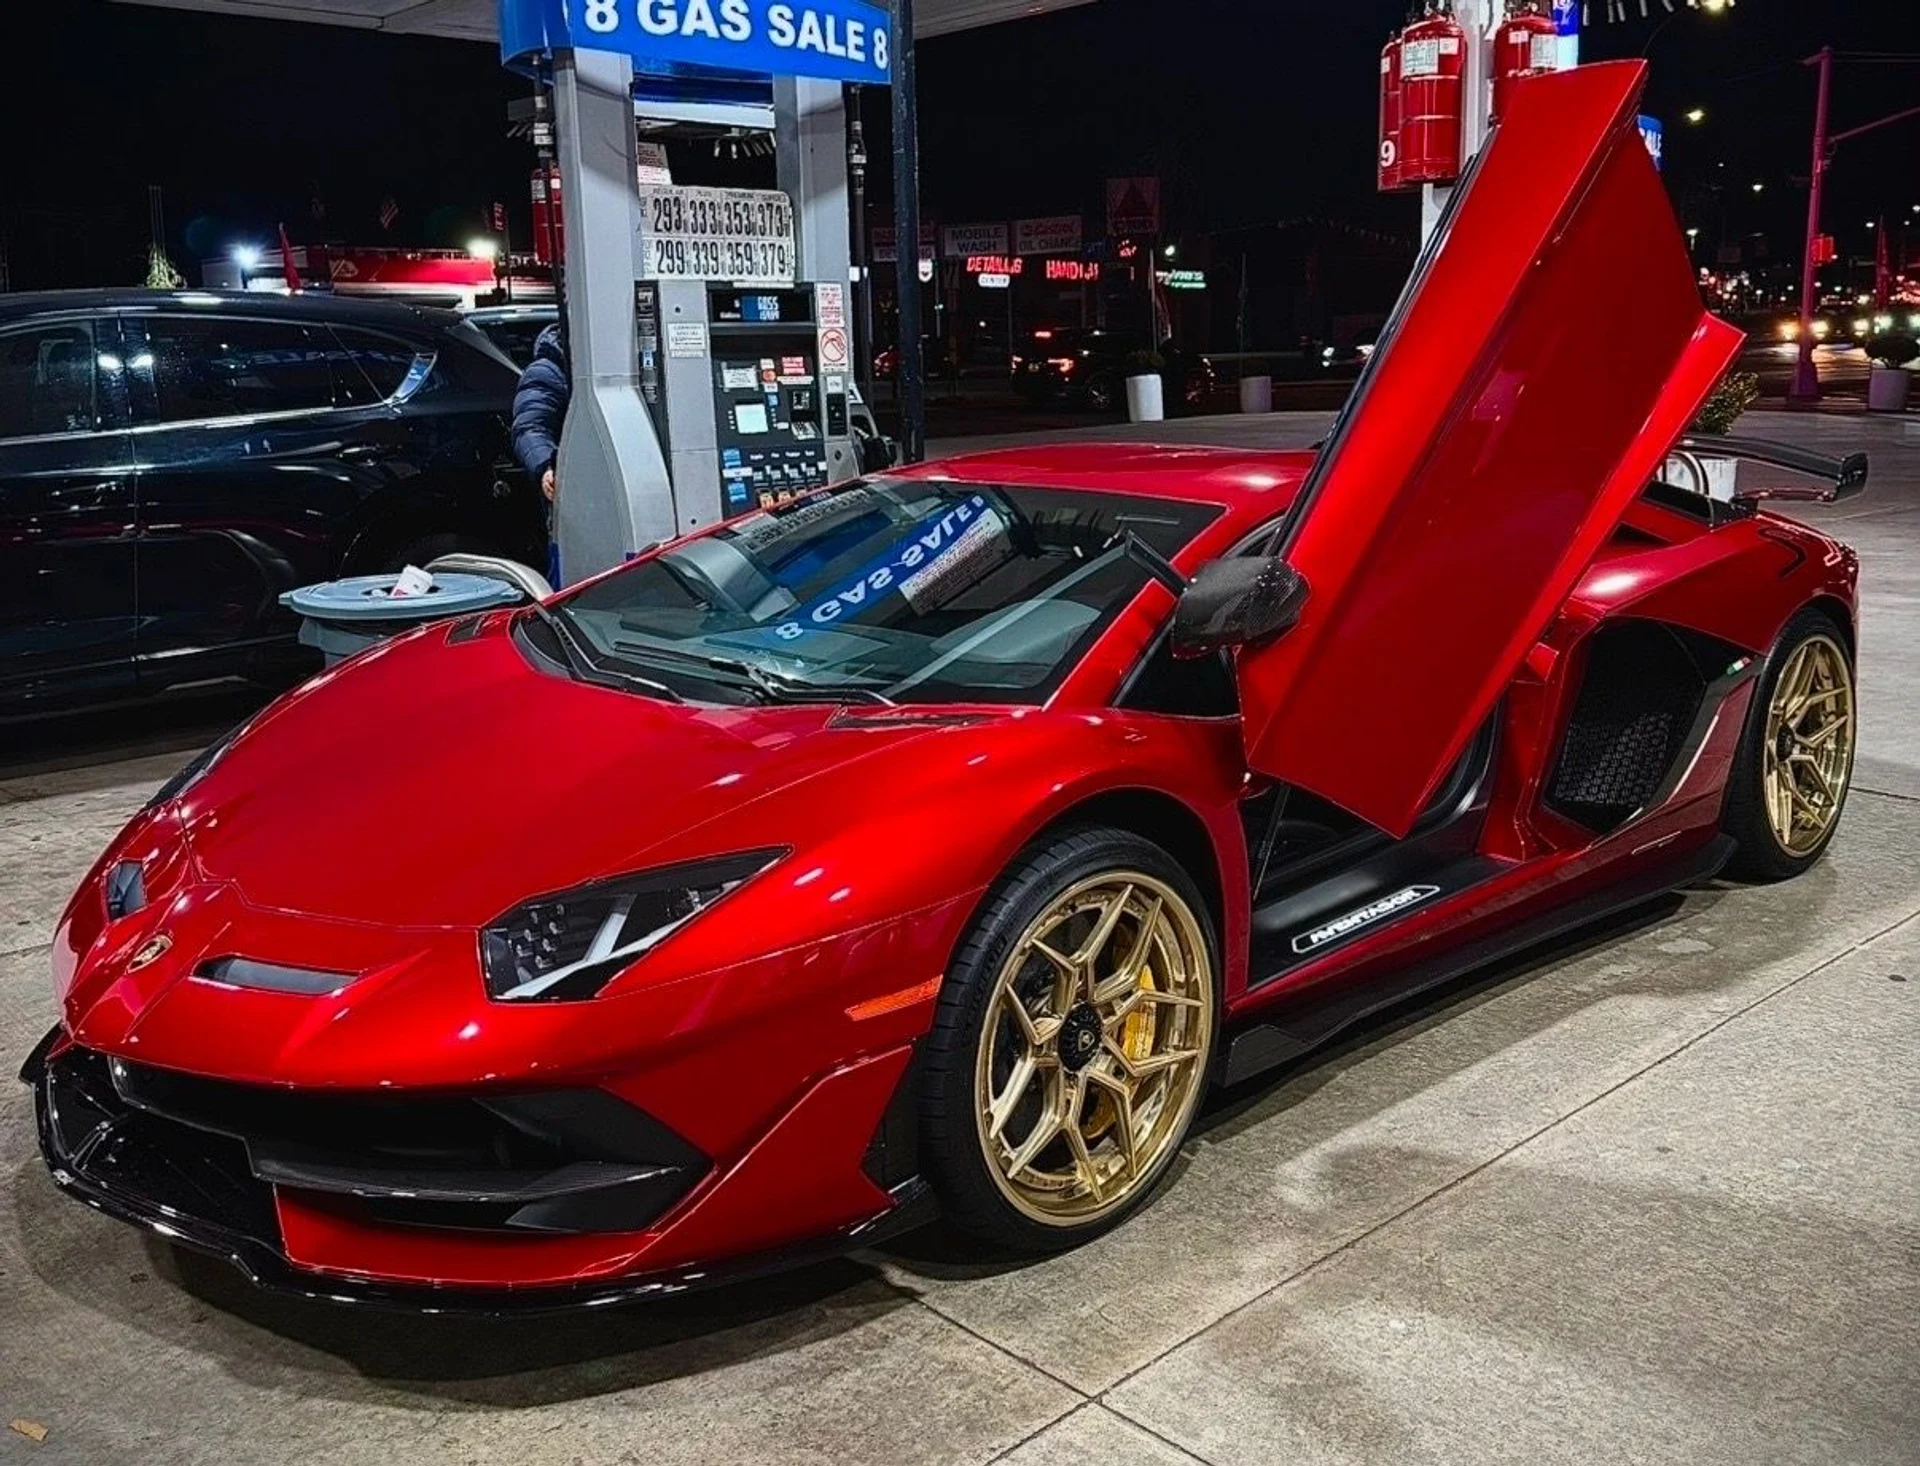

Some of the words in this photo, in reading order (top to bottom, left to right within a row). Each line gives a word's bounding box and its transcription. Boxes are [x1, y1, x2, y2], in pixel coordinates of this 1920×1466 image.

[584, 0, 619, 32] 8
[637, 0, 750, 41] GAS
[767, 4, 866, 62] SALE
[873, 27, 889, 70] 8
[1380, 140, 1395, 167] 9
[653, 196, 683, 233] 293
[689, 199, 717, 235] 333
[724, 201, 751, 236] 353
[758, 203, 784, 237] 373
[952, 227, 1004, 240] MOBILE
[957, 241, 996, 253] WASH
[1019, 240, 1036, 252] OIL
[656, 240, 685, 275] 299
[692, 240, 720, 275] 339
[727, 242, 753, 276] 359
[760, 243, 786, 276] 379
